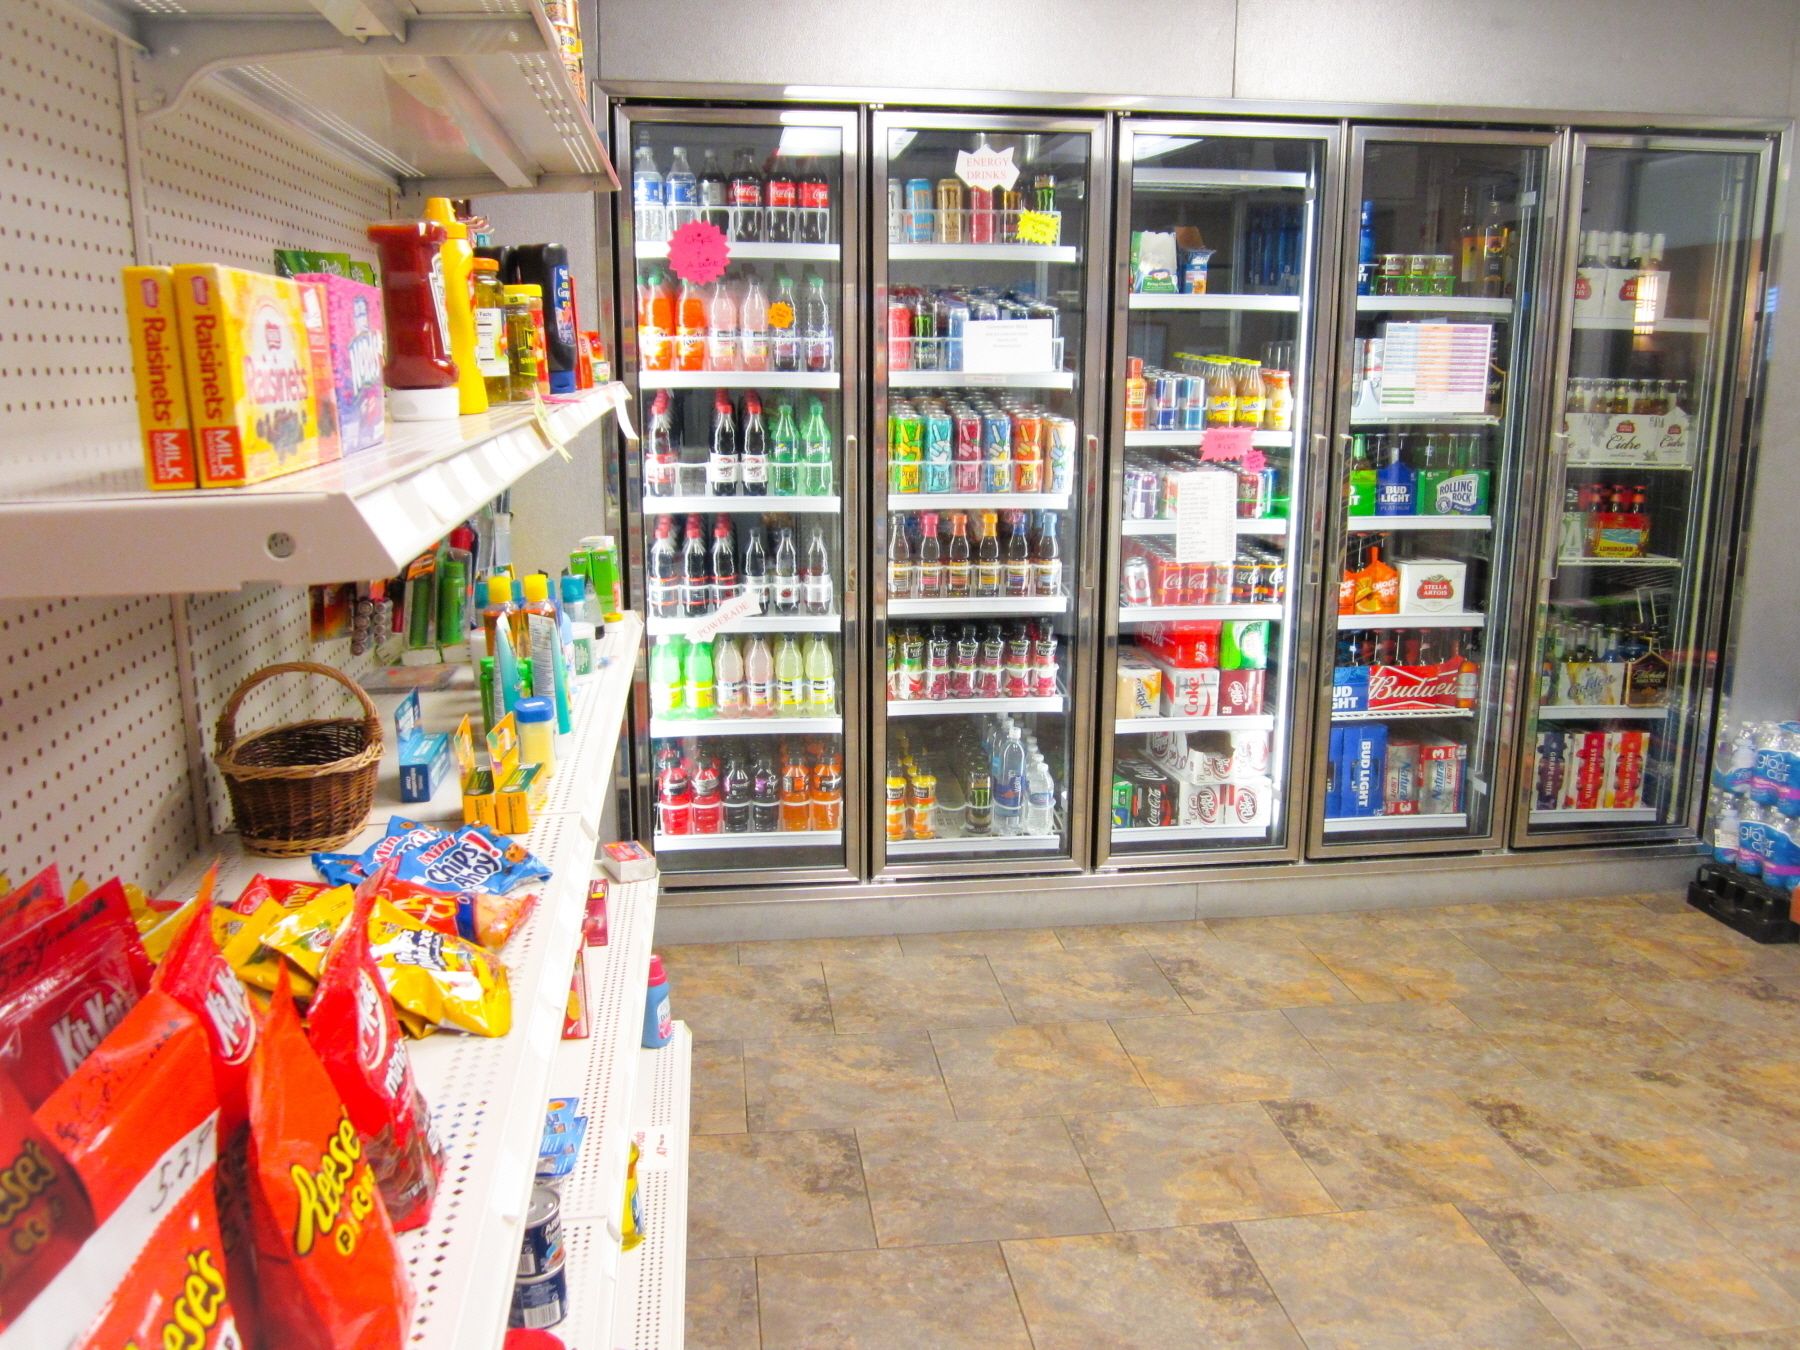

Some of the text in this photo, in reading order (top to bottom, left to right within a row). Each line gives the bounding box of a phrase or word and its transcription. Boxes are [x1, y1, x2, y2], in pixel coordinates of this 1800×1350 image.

[966, 157, 1009, 168] ENERGY
[966, 170, 1007, 180] DRINKS
[143, 317, 174, 422] Raisinets
[192, 313, 225, 421] Raisinets
[160, 432, 184, 480] MILK
[213, 429, 236, 476] MILK
[1606, 434, 1641, 451] Cidre
[1381, 494, 1410, 503] LIGHT
[1385, 485, 1407, 494] BUD
[1439, 481, 1473, 496] ROLLING
[1452, 492, 1472, 503] ROCK
[1372, 578, 1398, 592] SHOCK
[697, 601, 750, 638] POWERADE
[1185, 677, 1199, 715] Coke
[1332, 697, 1358, 709] GHT
[1361, 741, 1372, 769] BUD
[1432, 748, 1445, 758] 3
[1588, 748, 1598, 772] STRAW
[1359, 770, 1371, 807] LIGHT
[1399, 762, 1414, 801] Natural
[1432, 760, 1446, 800] Natural
[1148, 787, 1162, 826] Coca-Cola
[1400, 802, 1411, 812] 3
[418, 833, 457, 865] Mini
[427, 842, 479, 883] Chips
[454, 852, 500, 888] Ahoy
[51, 1014, 98, 1076] Kit
[149, 1119, 215, 1213] 5.29
